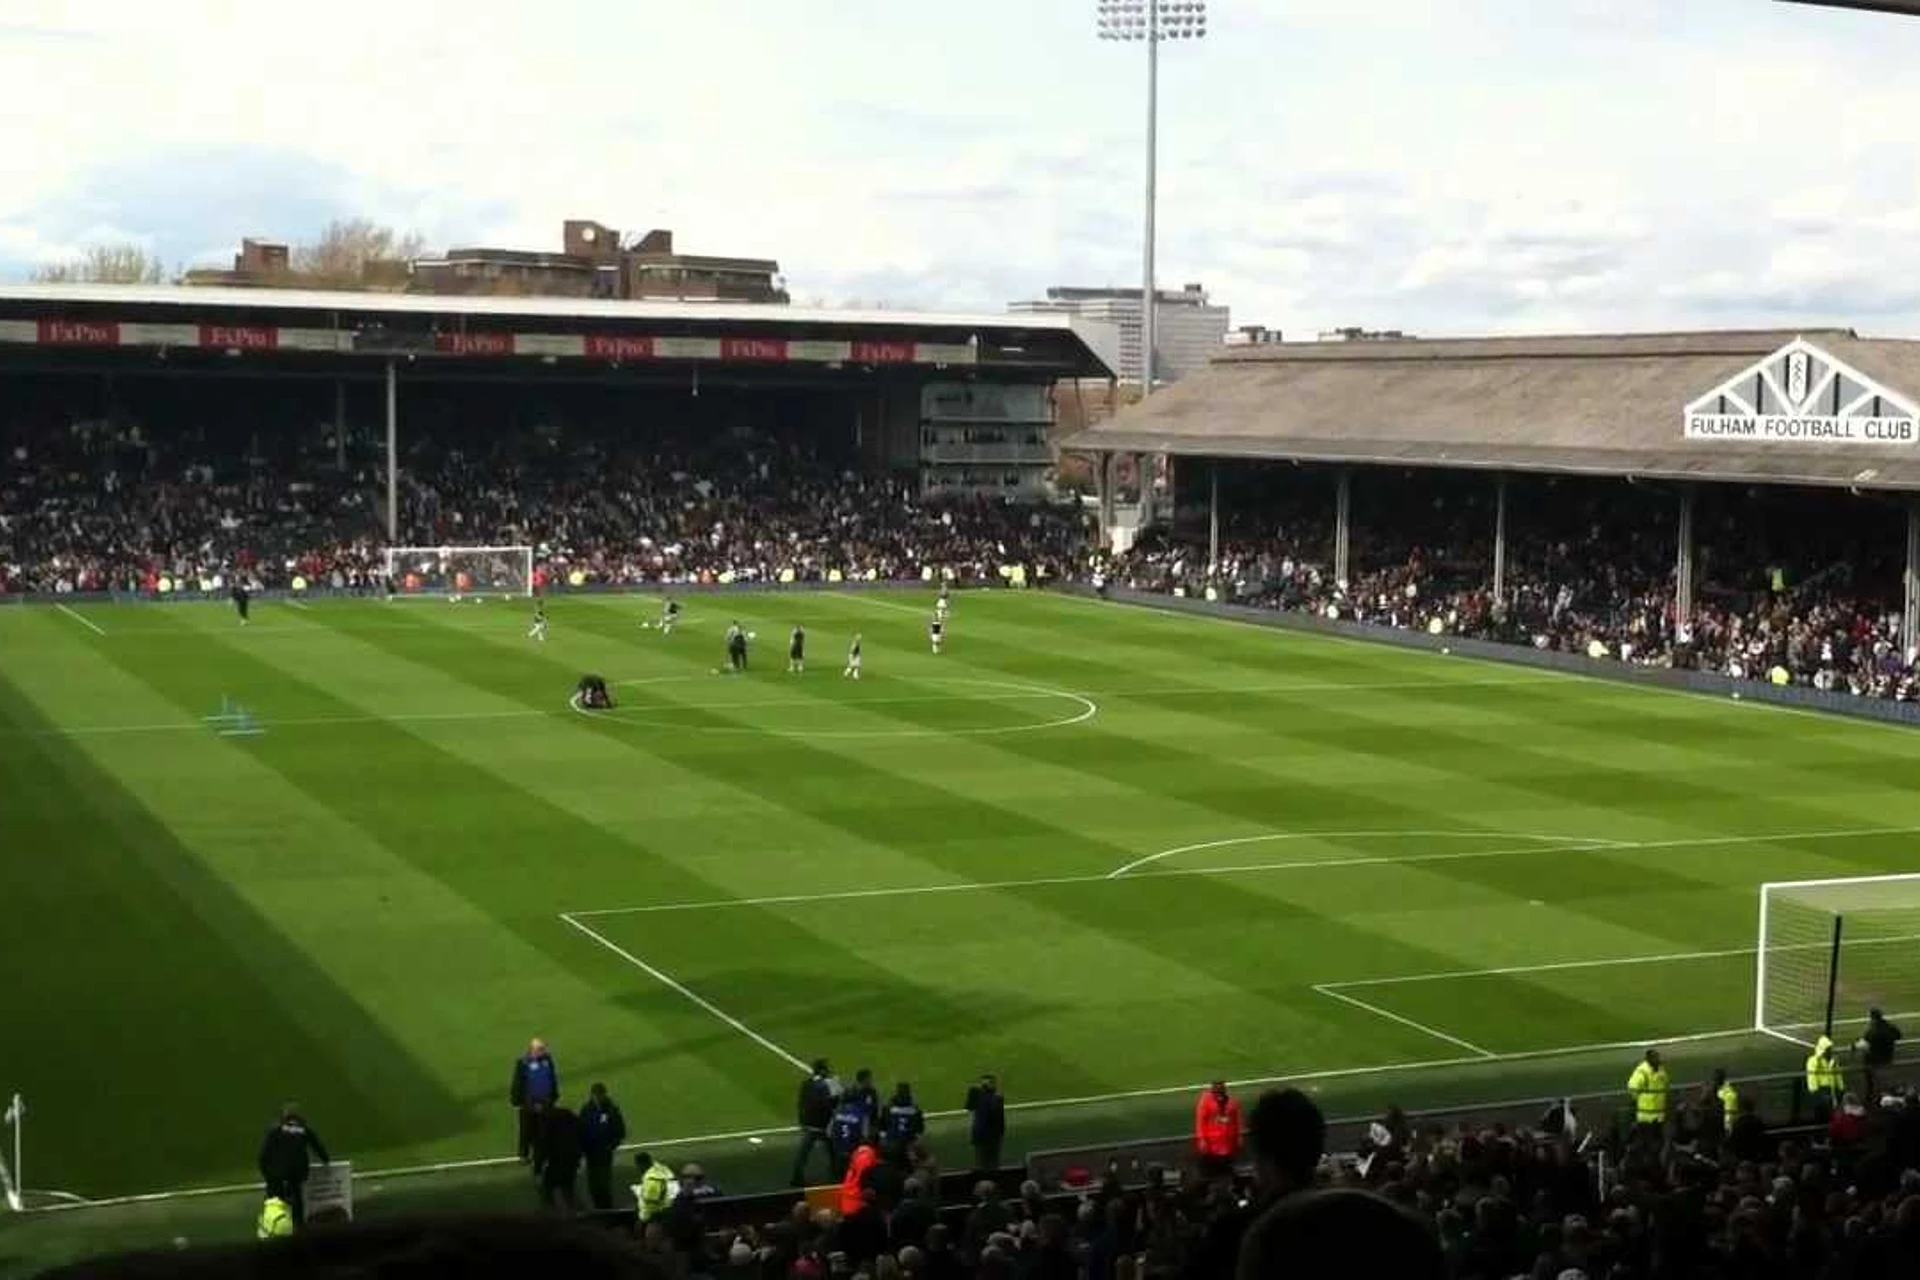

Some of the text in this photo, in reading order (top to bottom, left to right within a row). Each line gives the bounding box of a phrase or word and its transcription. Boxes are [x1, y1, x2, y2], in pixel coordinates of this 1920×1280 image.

[1691, 417, 1911, 439] FULHAM FOOTBALL CLUB
